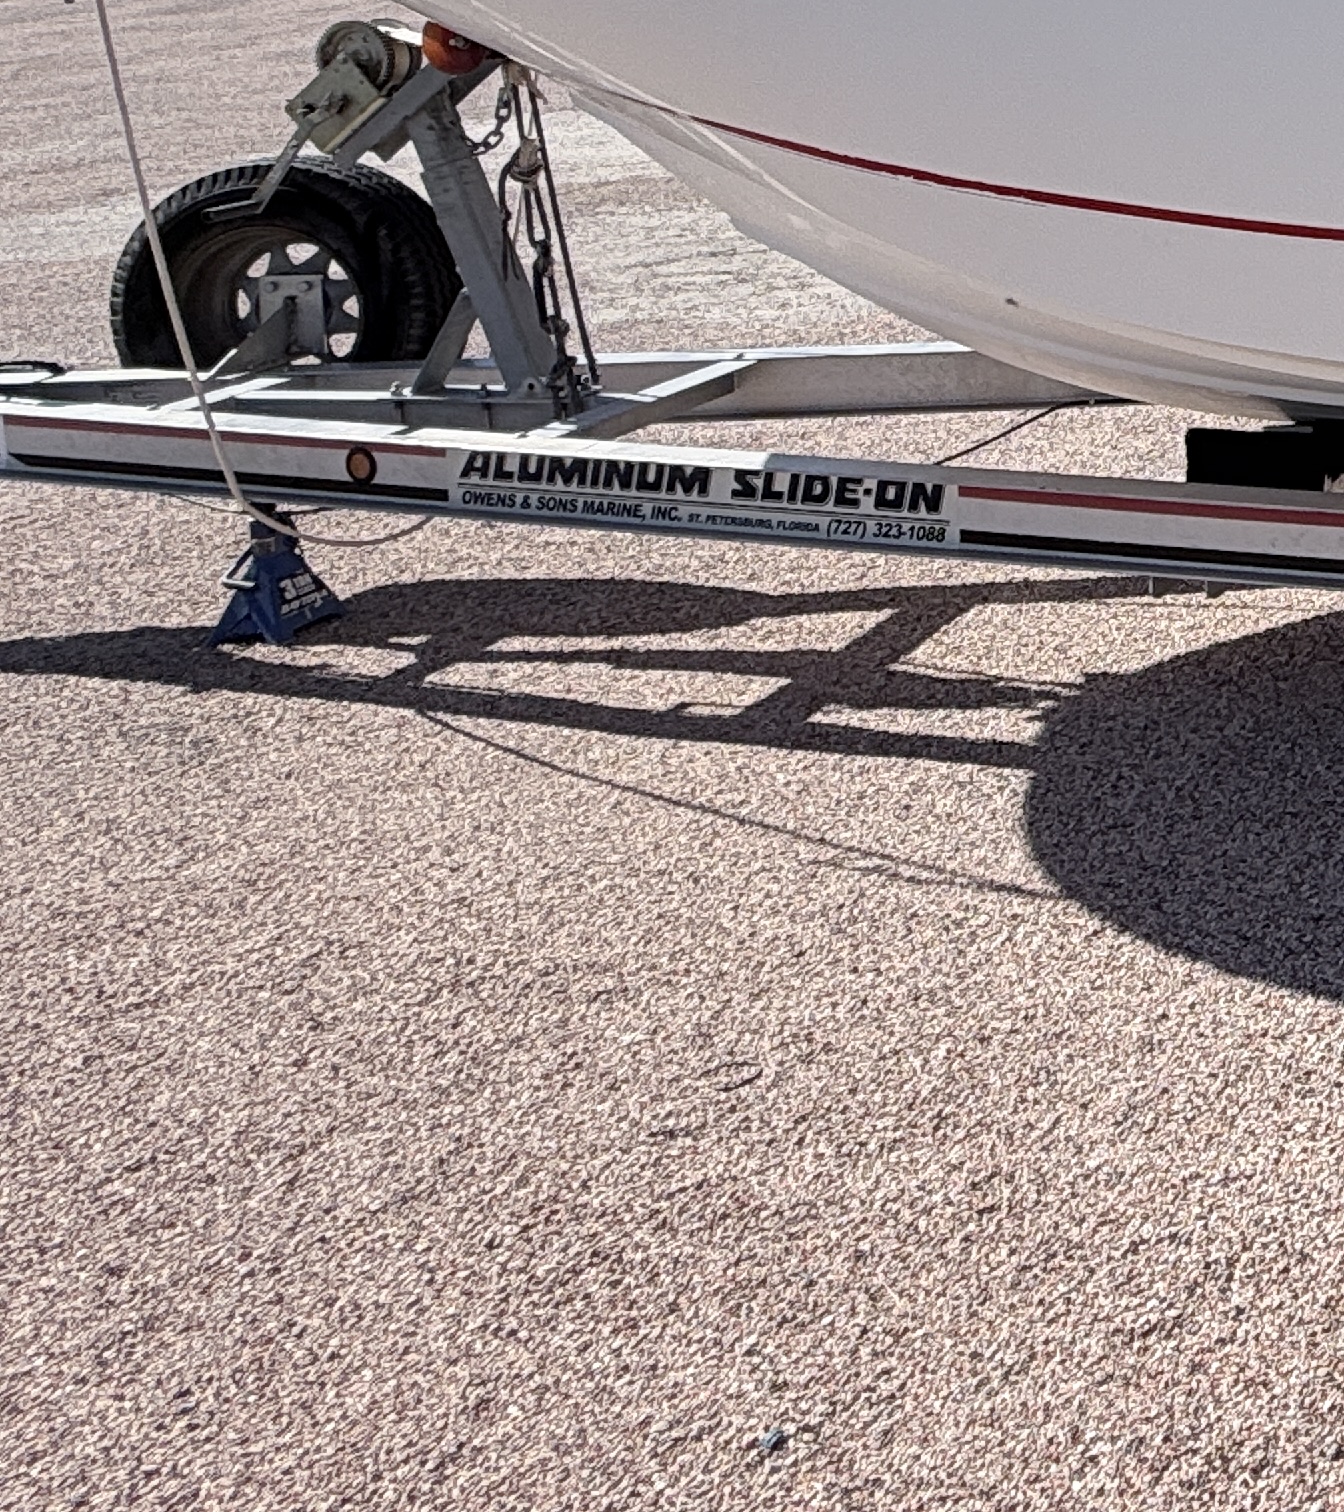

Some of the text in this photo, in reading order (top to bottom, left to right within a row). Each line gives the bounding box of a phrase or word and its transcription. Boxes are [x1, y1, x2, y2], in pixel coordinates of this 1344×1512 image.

[459, 451, 944, 514] ALUMINUM SLIDE-ON
[462, 490, 516, 508] OWENS
[520, 494, 532, 509] &
[535, 496, 578, 513] SONS
[581, 500, 646, 522] MARINE,
[650, 506, 682, 522] INC.
[687, 513, 703, 524] ST.
[826, 519, 867, 539] (727)
[872, 522, 946, 543] 323-1088
